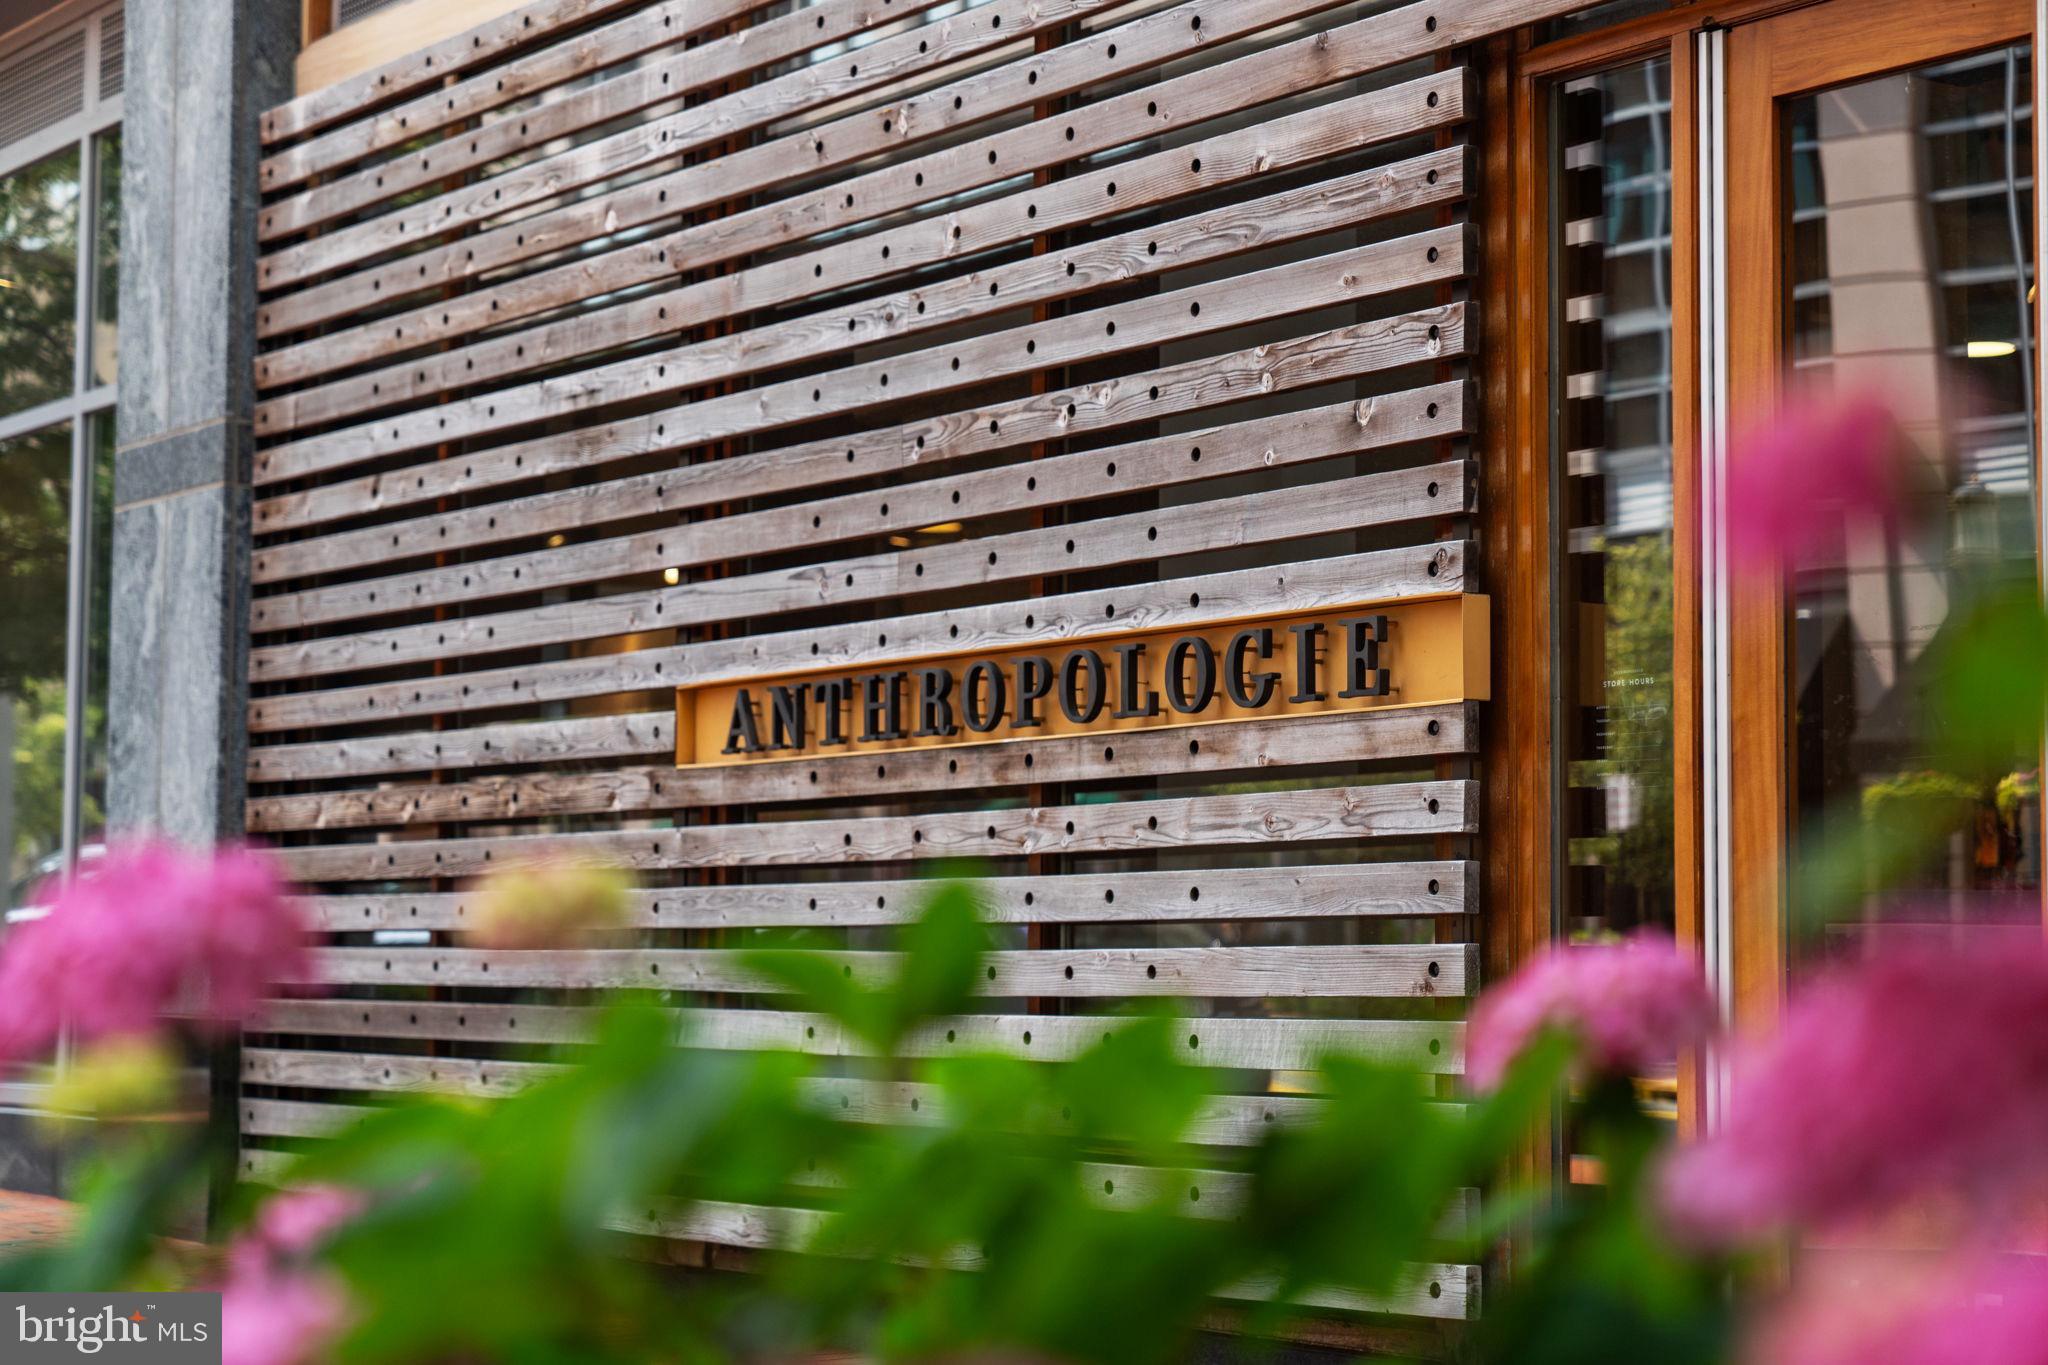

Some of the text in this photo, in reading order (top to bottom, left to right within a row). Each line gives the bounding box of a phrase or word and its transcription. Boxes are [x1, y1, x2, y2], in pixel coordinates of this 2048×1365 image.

[721, 615, 1391, 754] ANTHROPOLOGIE
[1603, 677, 1654, 688] STORE HOURS
